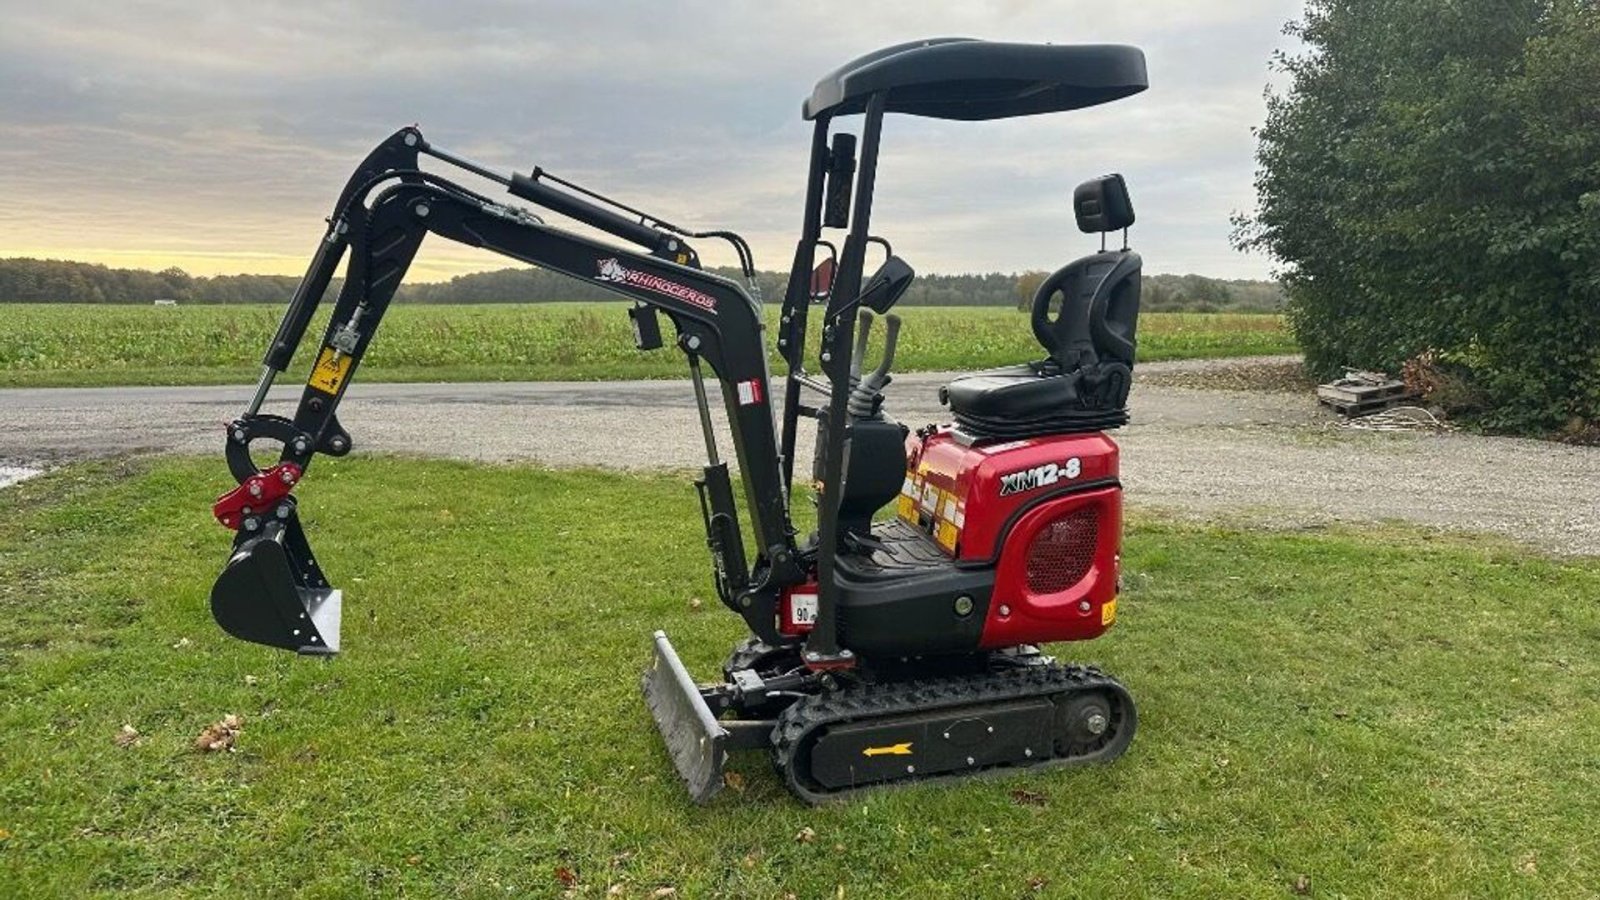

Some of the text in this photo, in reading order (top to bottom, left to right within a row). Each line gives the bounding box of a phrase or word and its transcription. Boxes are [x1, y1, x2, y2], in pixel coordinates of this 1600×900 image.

[627, 269, 716, 308] RHINOCEROS
[1000, 457, 1081, 496] XN12-8
[796, 607, 809, 622] 90
